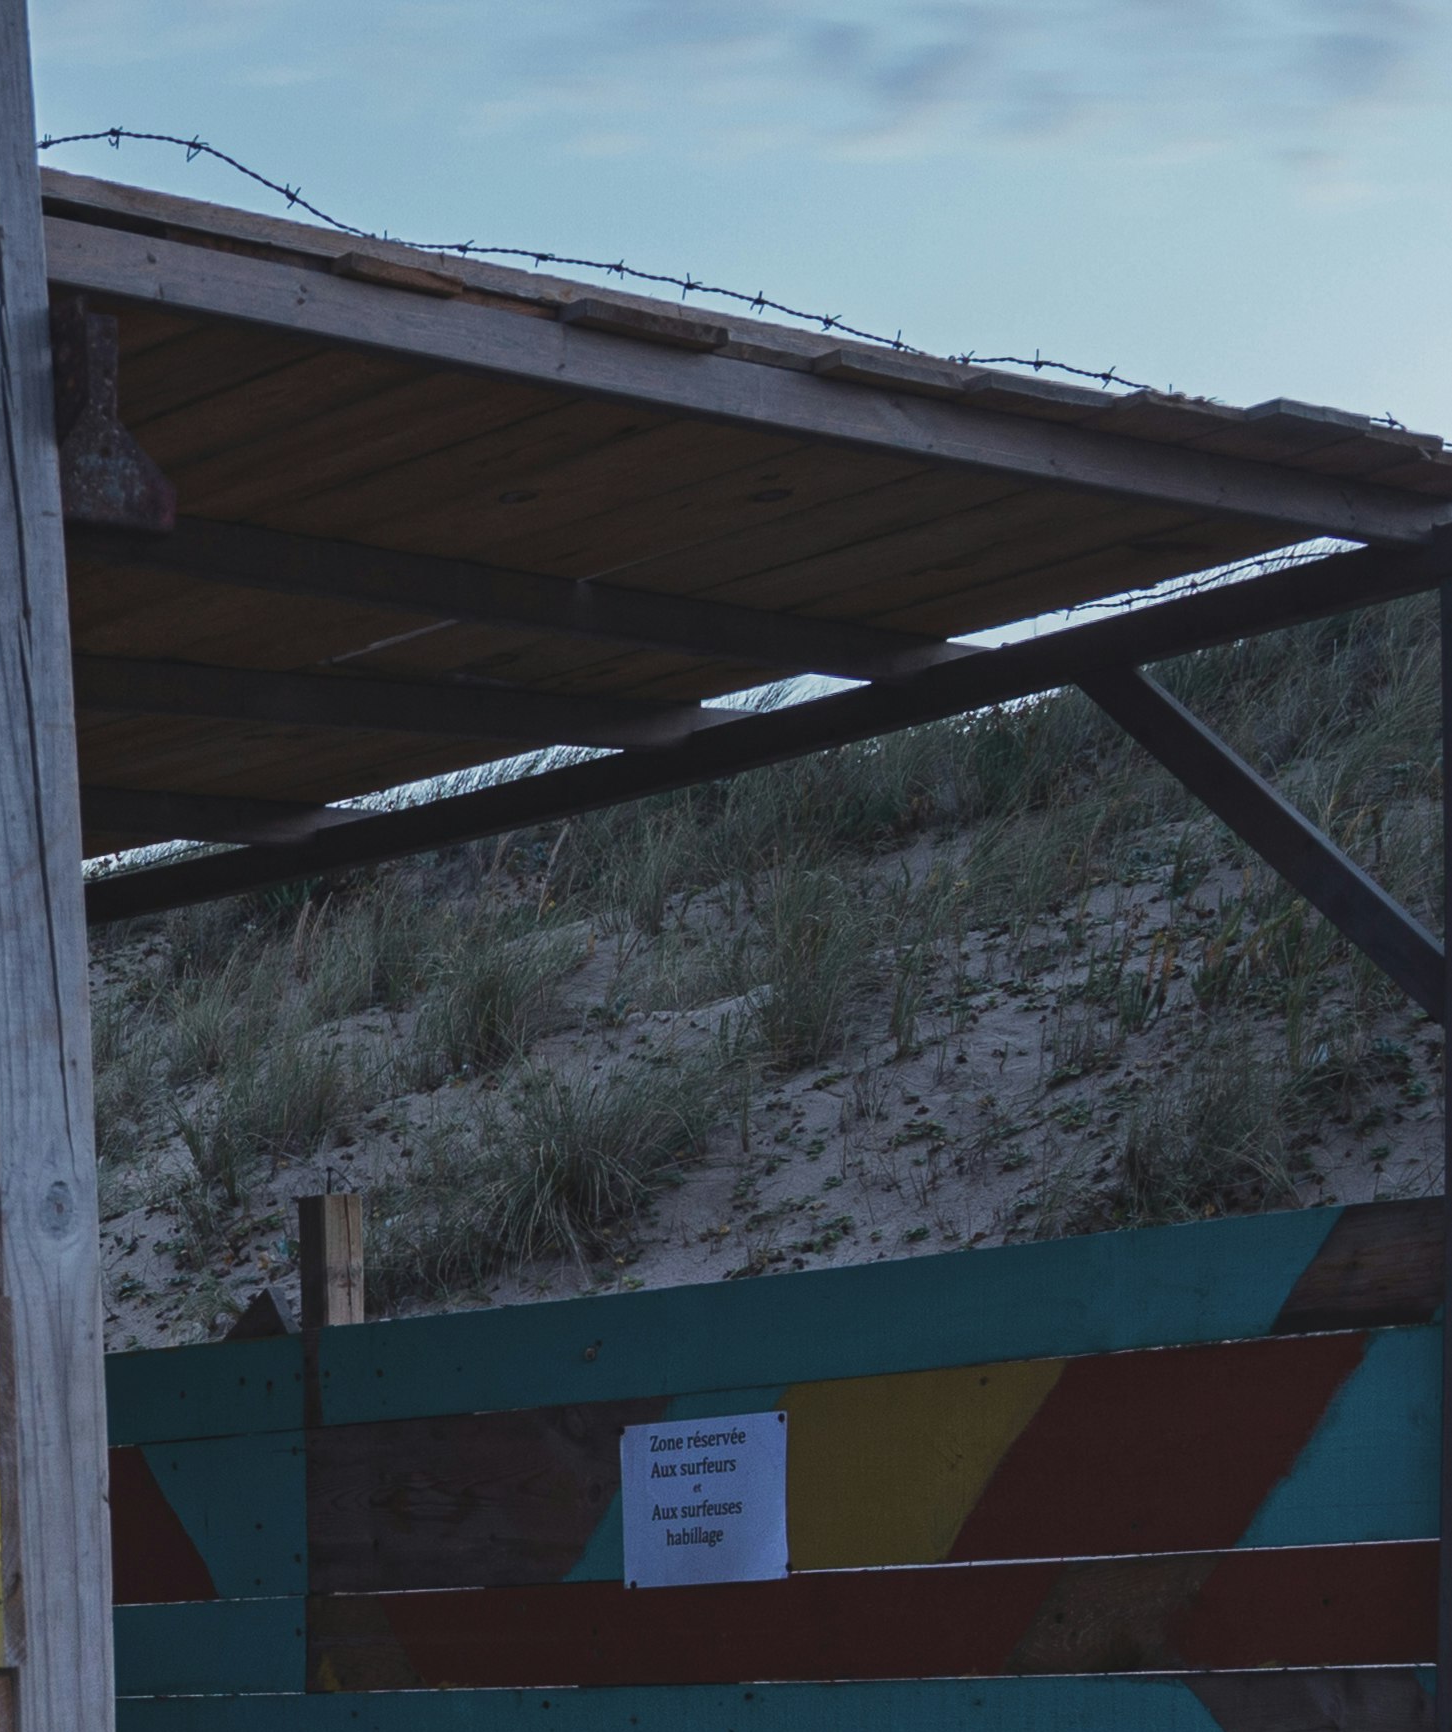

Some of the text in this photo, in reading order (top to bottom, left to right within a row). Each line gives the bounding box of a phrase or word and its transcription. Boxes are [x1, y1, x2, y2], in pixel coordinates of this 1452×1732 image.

[650, 1427, 746, 1452] Zone réservée
[651, 1457, 736, 1479] Aux surfeurs
[693, 1483, 702, 1493] et
[651, 1499, 743, 1521] Aux surfeuses
[666, 1526, 724, 1548] habillage
